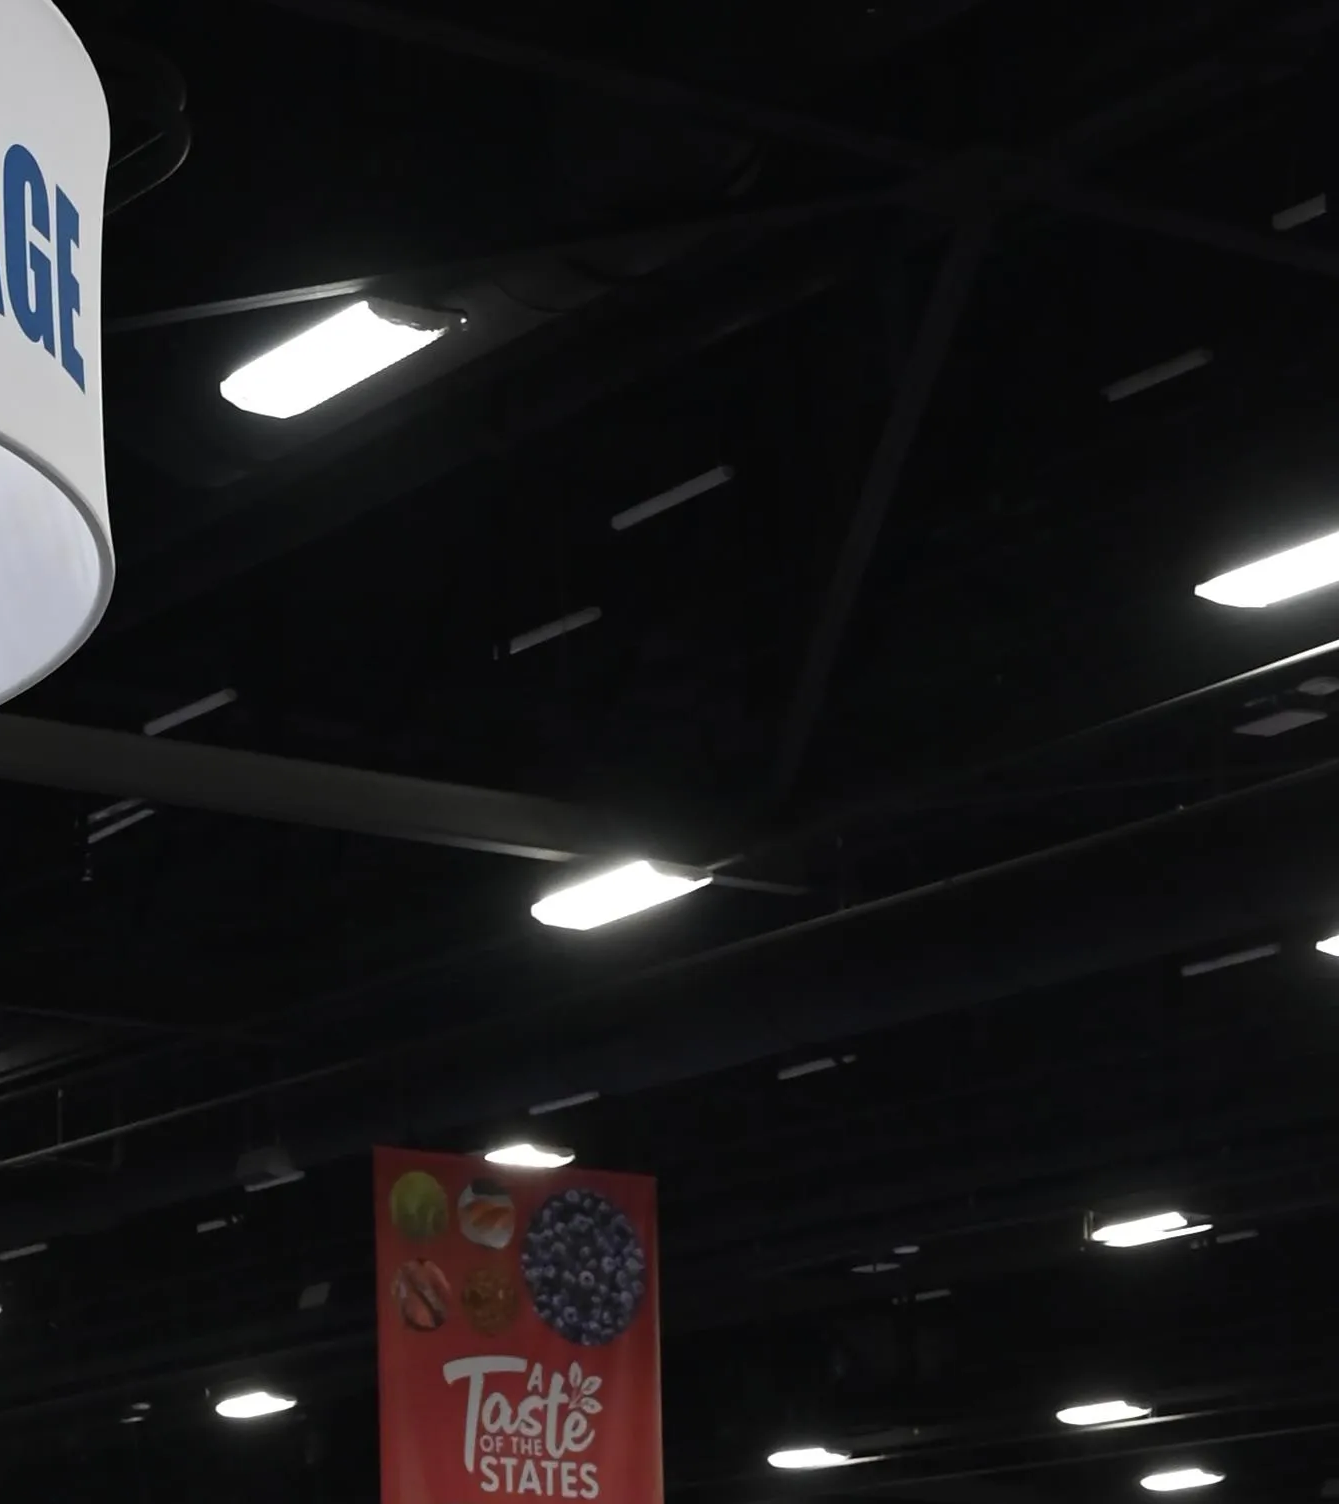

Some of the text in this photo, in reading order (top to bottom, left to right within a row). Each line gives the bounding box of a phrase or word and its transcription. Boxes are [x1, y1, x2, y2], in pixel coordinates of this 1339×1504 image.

[527, 1362, 543, 1393] A
[443, 1355, 595, 1474] Taste
[480, 1434, 543, 1457] OF THE
[480, 1456, 600, 1499] STATES
